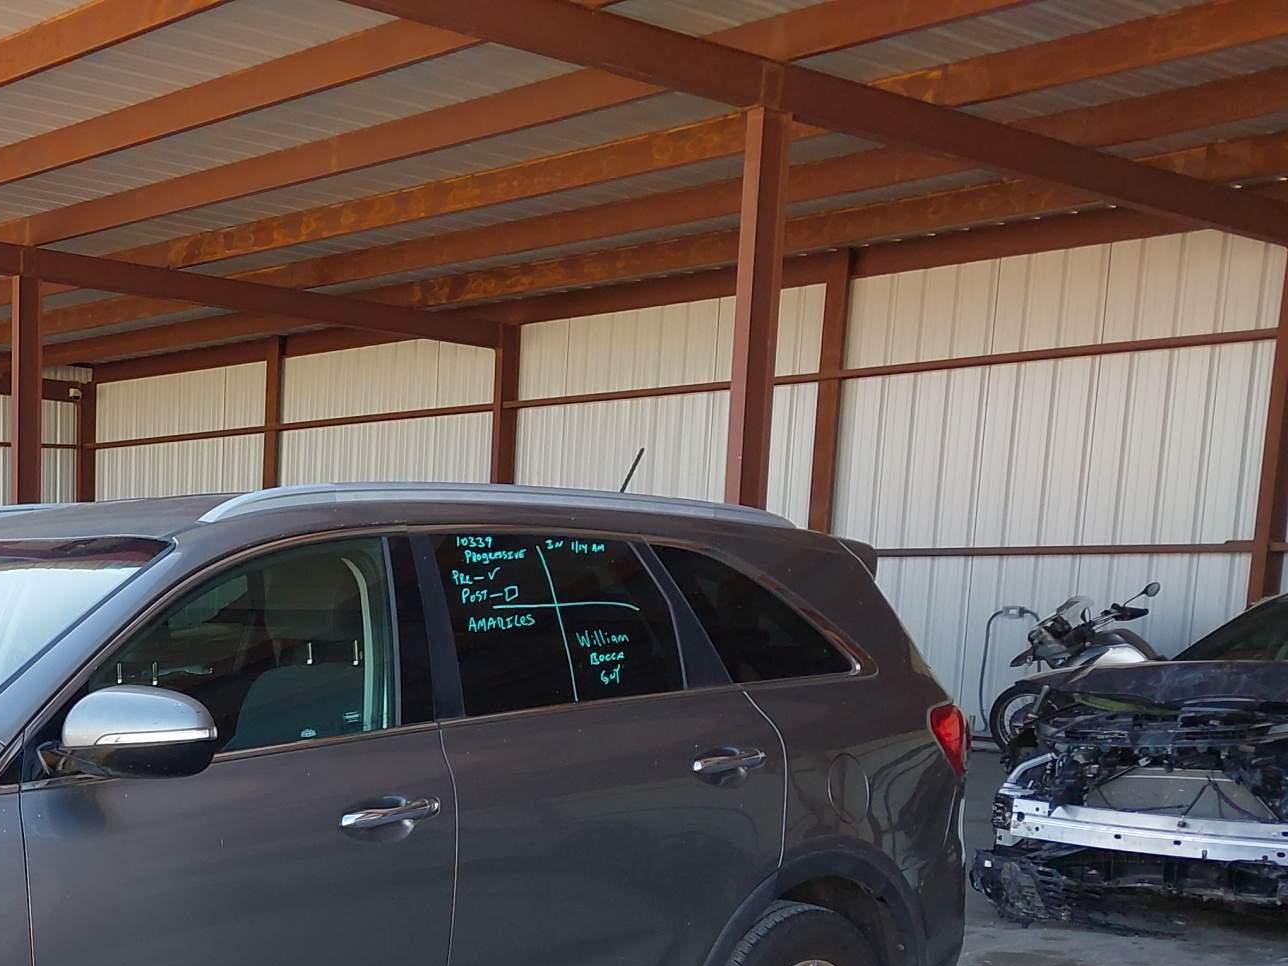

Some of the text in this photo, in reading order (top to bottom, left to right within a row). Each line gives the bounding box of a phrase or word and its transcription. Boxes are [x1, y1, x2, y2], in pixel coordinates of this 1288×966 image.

[456, 535, 493, 549] 10339
[592, 543, 605, 553] AM
[575, 629, 630, 648] William
